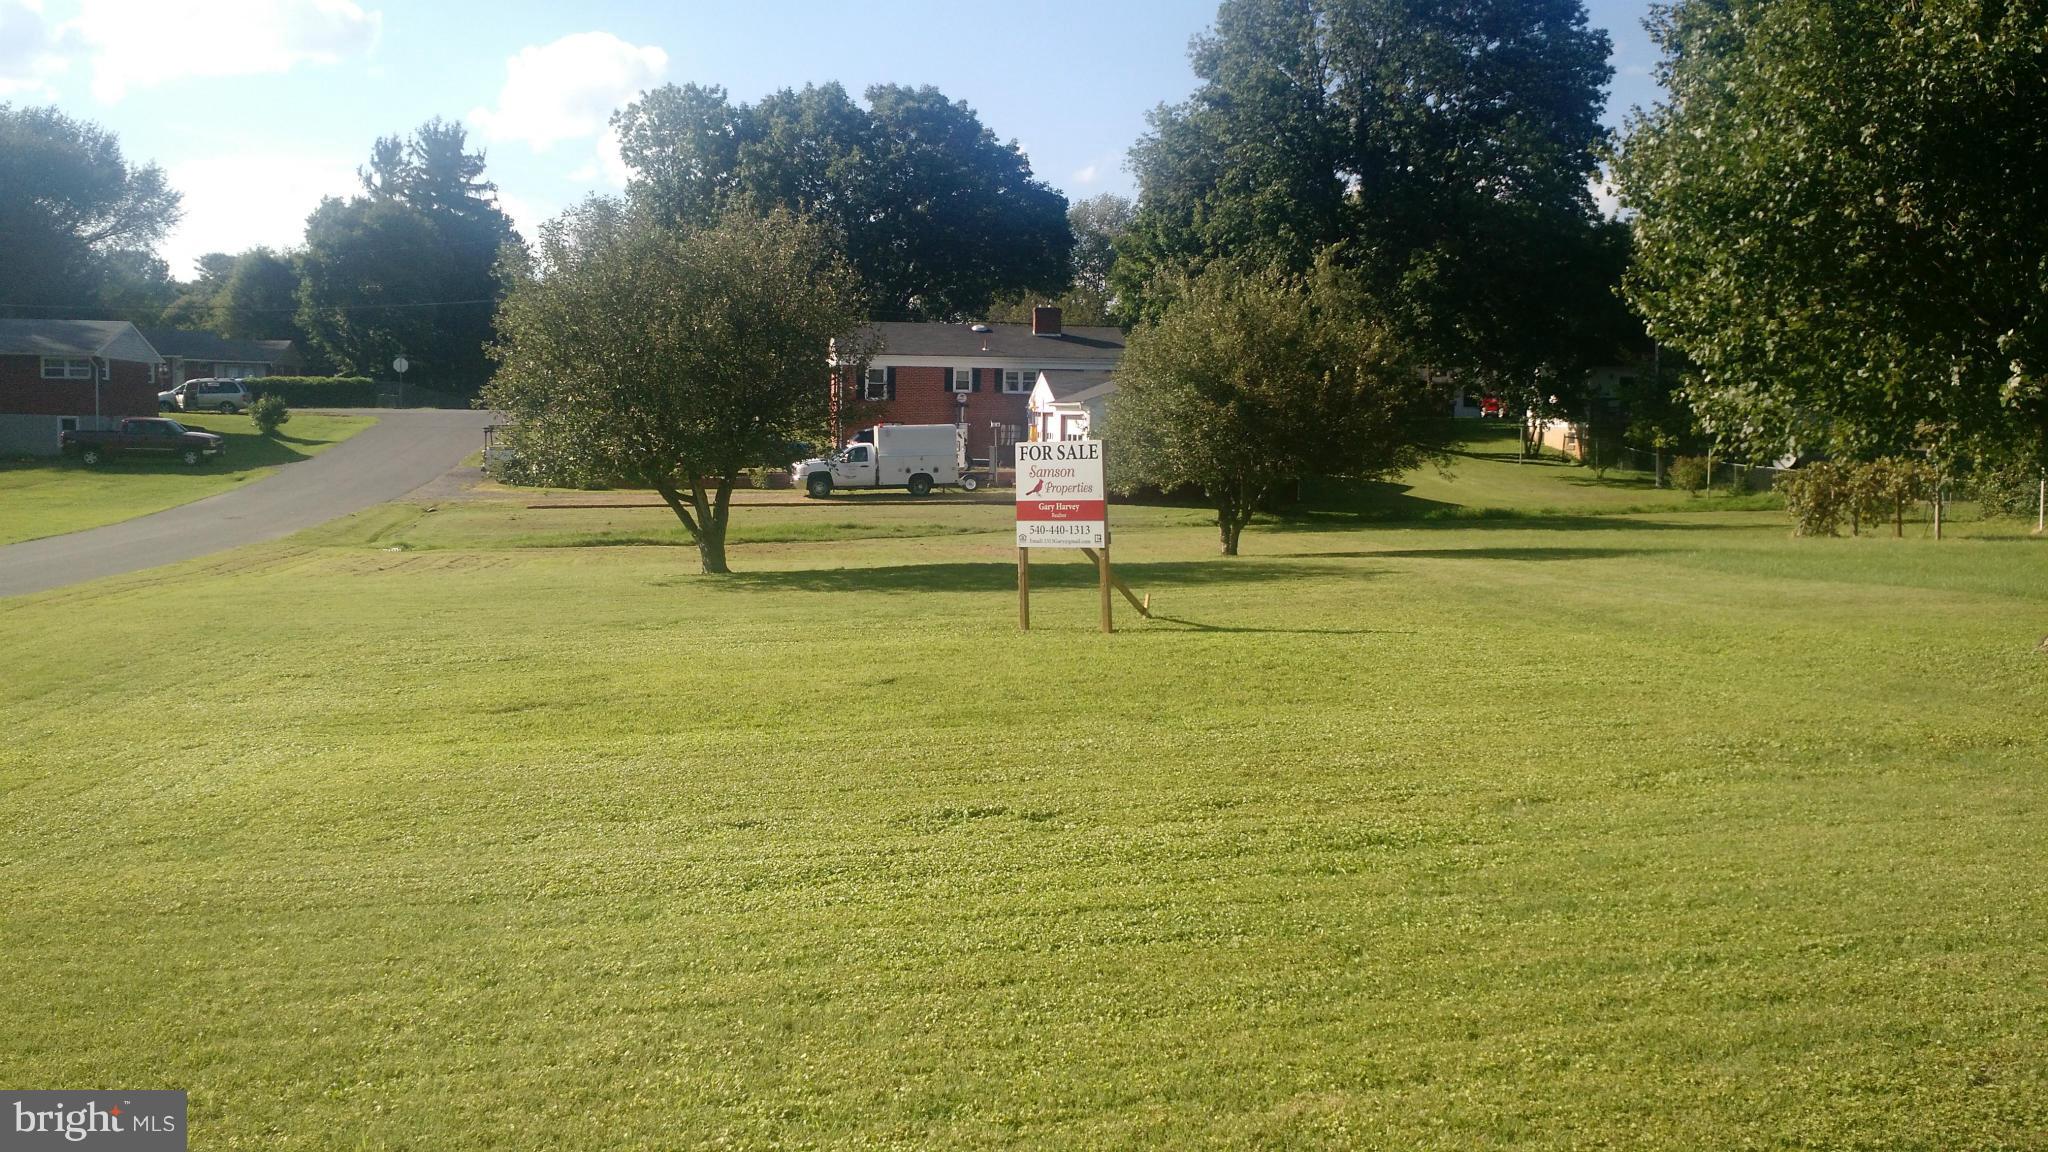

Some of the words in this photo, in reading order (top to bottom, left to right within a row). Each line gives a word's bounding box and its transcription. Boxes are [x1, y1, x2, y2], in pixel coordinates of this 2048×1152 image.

[1019, 445, 1053, 461] FOR
[1057, 444, 1098, 460] SALE
[1029, 464, 1075, 478] Samson
[1045, 481, 1093, 495] Properties
[1038, 502, 1055, 512] Gary
[1056, 502, 1080, 512] Harvey
[1029, 525, 1090, 535] 540-440-1313
